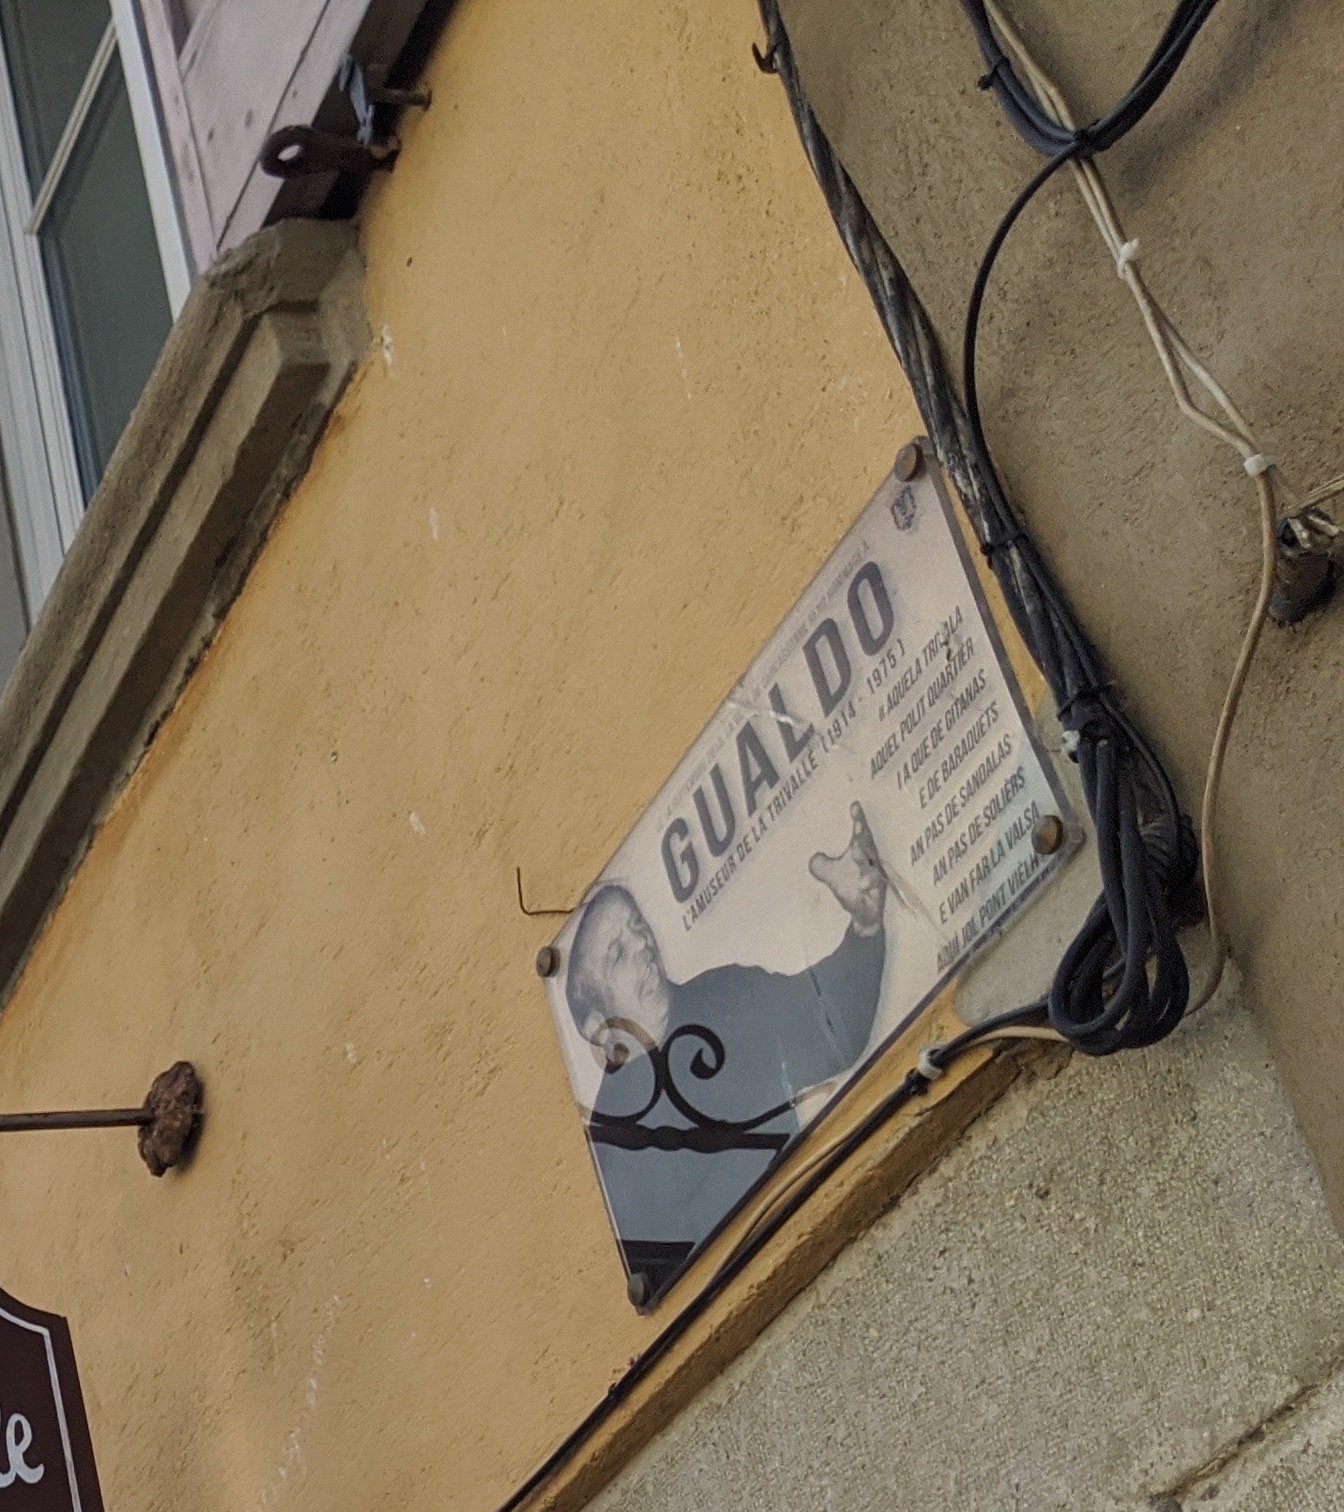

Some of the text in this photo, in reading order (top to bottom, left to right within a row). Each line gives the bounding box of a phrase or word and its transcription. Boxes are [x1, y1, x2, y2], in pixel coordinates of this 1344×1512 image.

[661, 560, 895, 904] GUALDO
[870, 732, 900, 780] AQUEL
[899, 695, 926, 742] POLIT
[910, 736, 932, 774] QUE
[930, 718, 945, 750] DE
[944, 668, 986, 732] GITANAS
[926, 769, 942, 801] DE
[940, 700, 999, 783] BARAQUETS
[682, 853, 737, 931] L'AMUSEUR
[735, 834, 753, 863] DE
[751, 815, 768, 843] LA
[766, 747, 819, 822] TRIVALLE
[910, 733, 1012, 866] AN PAS DE SANDALAS
[933, 765, 1026, 886] AN PAS DE SOLIÈRS
[947, 878, 970, 915] VAN
[969, 855, 993, 893] FAR
[989, 839, 1006, 869] LA
[1004, 800, 1043, 851] VALSA
[978, 882, 1007, 929] PONT
